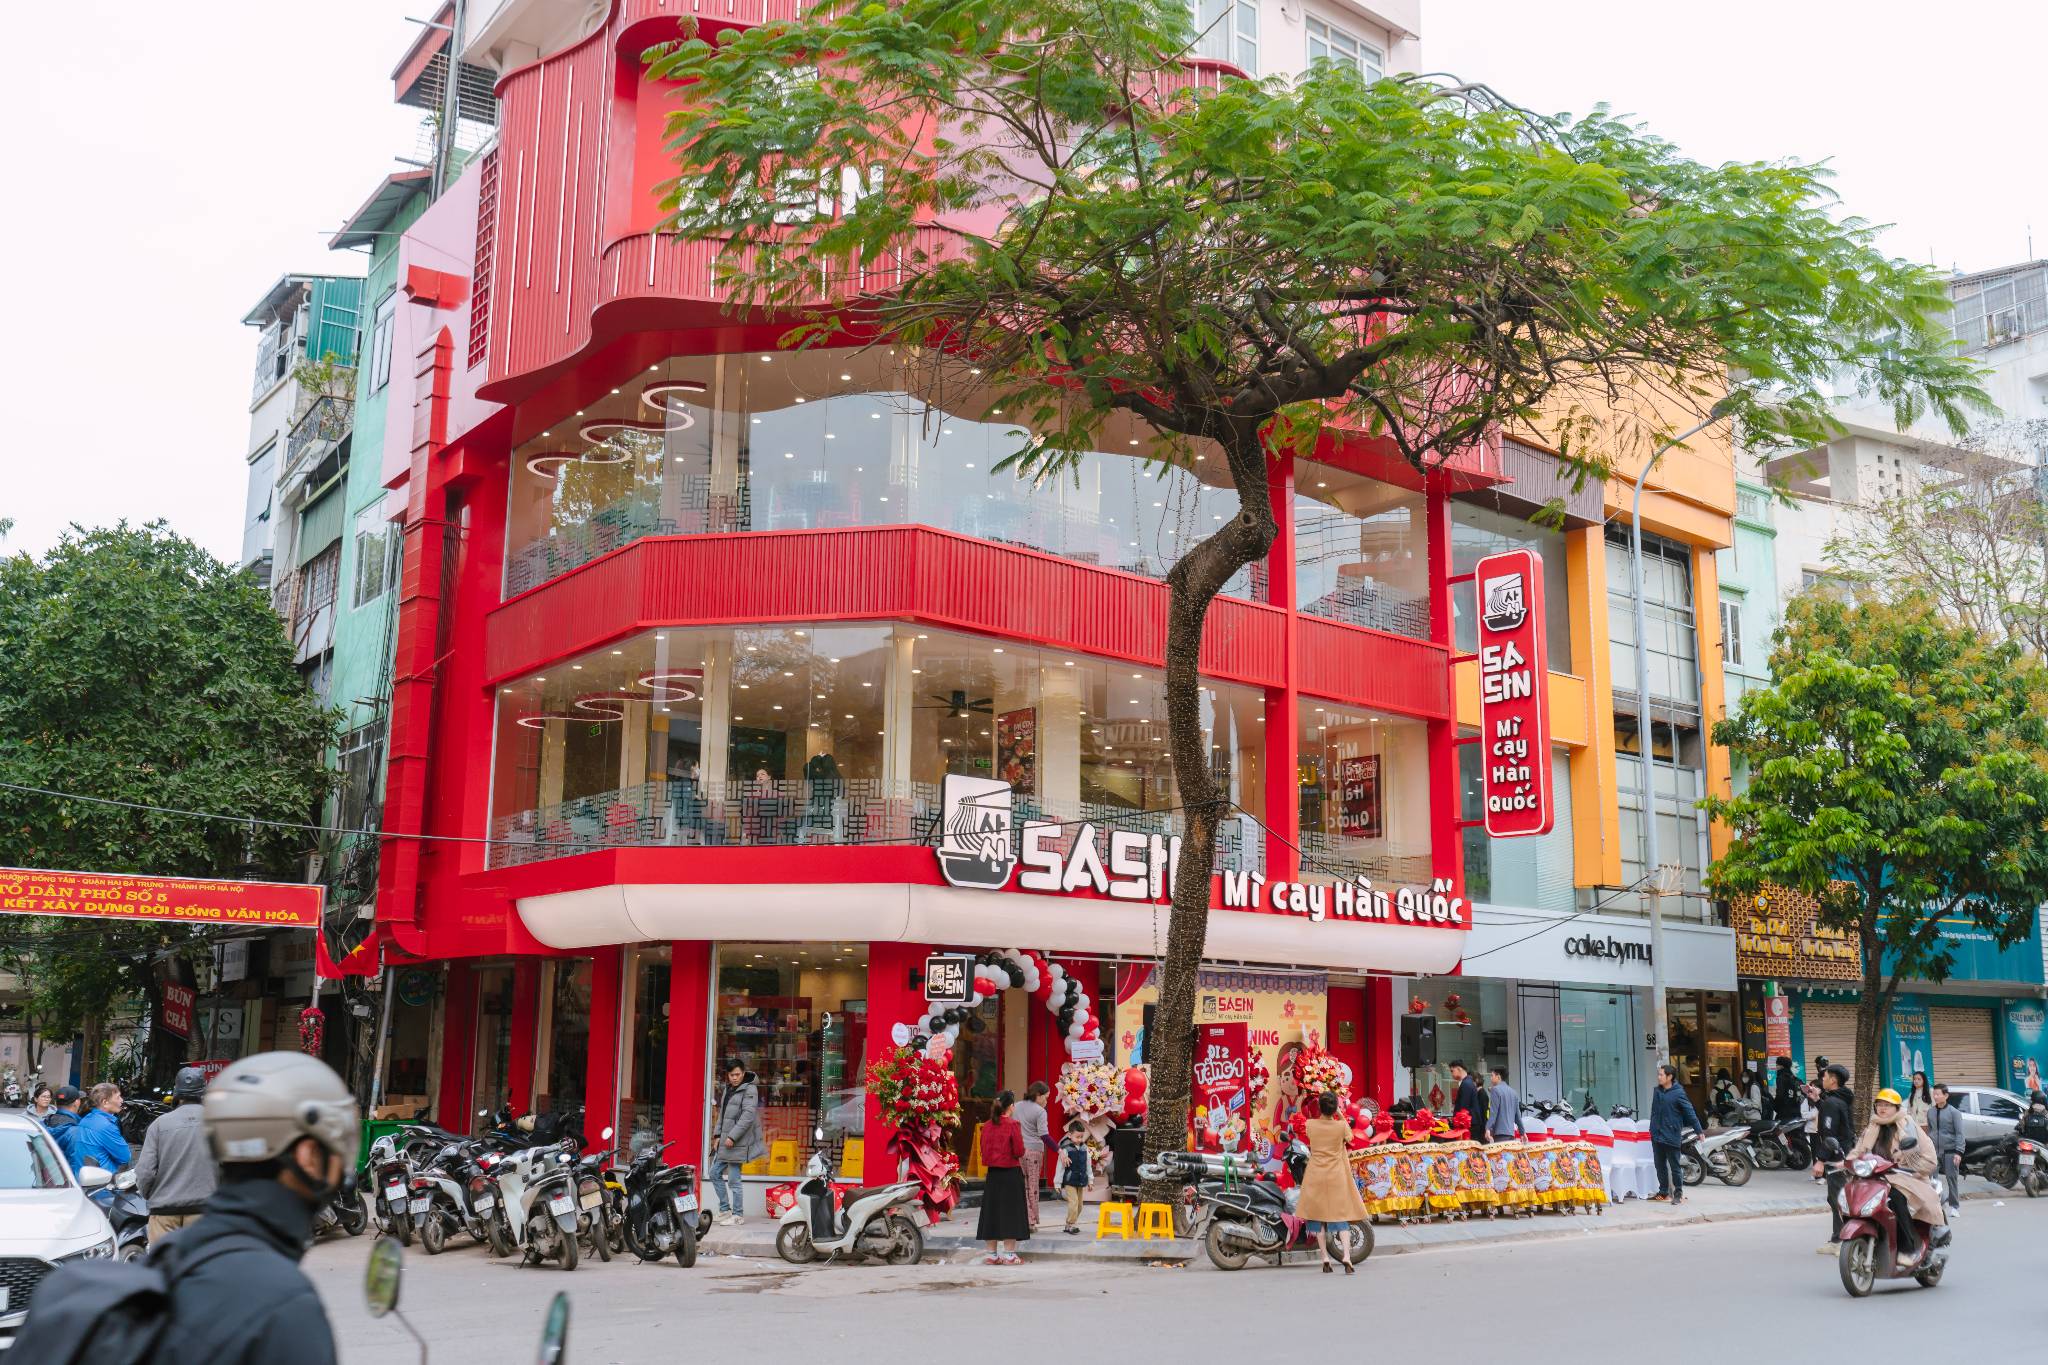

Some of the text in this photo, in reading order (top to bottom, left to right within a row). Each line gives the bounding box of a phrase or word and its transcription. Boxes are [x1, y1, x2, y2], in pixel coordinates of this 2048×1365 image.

[1483, 640, 1525, 673] SA
[1484, 670, 1532, 704] SIN
[1497, 715, 1522, 738] Mì
[1493, 739, 1528, 758] cay
[1492, 757, 1531, 783] Hàn
[1488, 782, 1537, 812] Quốc
[28, 884, 74, 898] DÂN
[79, 886, 122, 901] PHỐ
[126, 888, 154, 902] SỐ
[157, 893, 167, 902] 5
[1223, 869, 1266, 908] Mì
[1272, 881, 1326, 922] cay
[1333, 875, 1389, 919] Hàn
[1396, 878, 1463, 923] Quốc
[4, 895, 300, 921] KẾT XÂY DỰNG ĐỜI SỐNG VĂN HÓA
[946, 964, 963, 979] SA
[167, 986, 192, 1008] BÚN
[945, 980, 964, 995] SIN
[1218, 996, 1254, 1012] SASIN
[166, 1010, 188, 1031] CHẢ
[1221, 1046, 1230, 1059] 2
